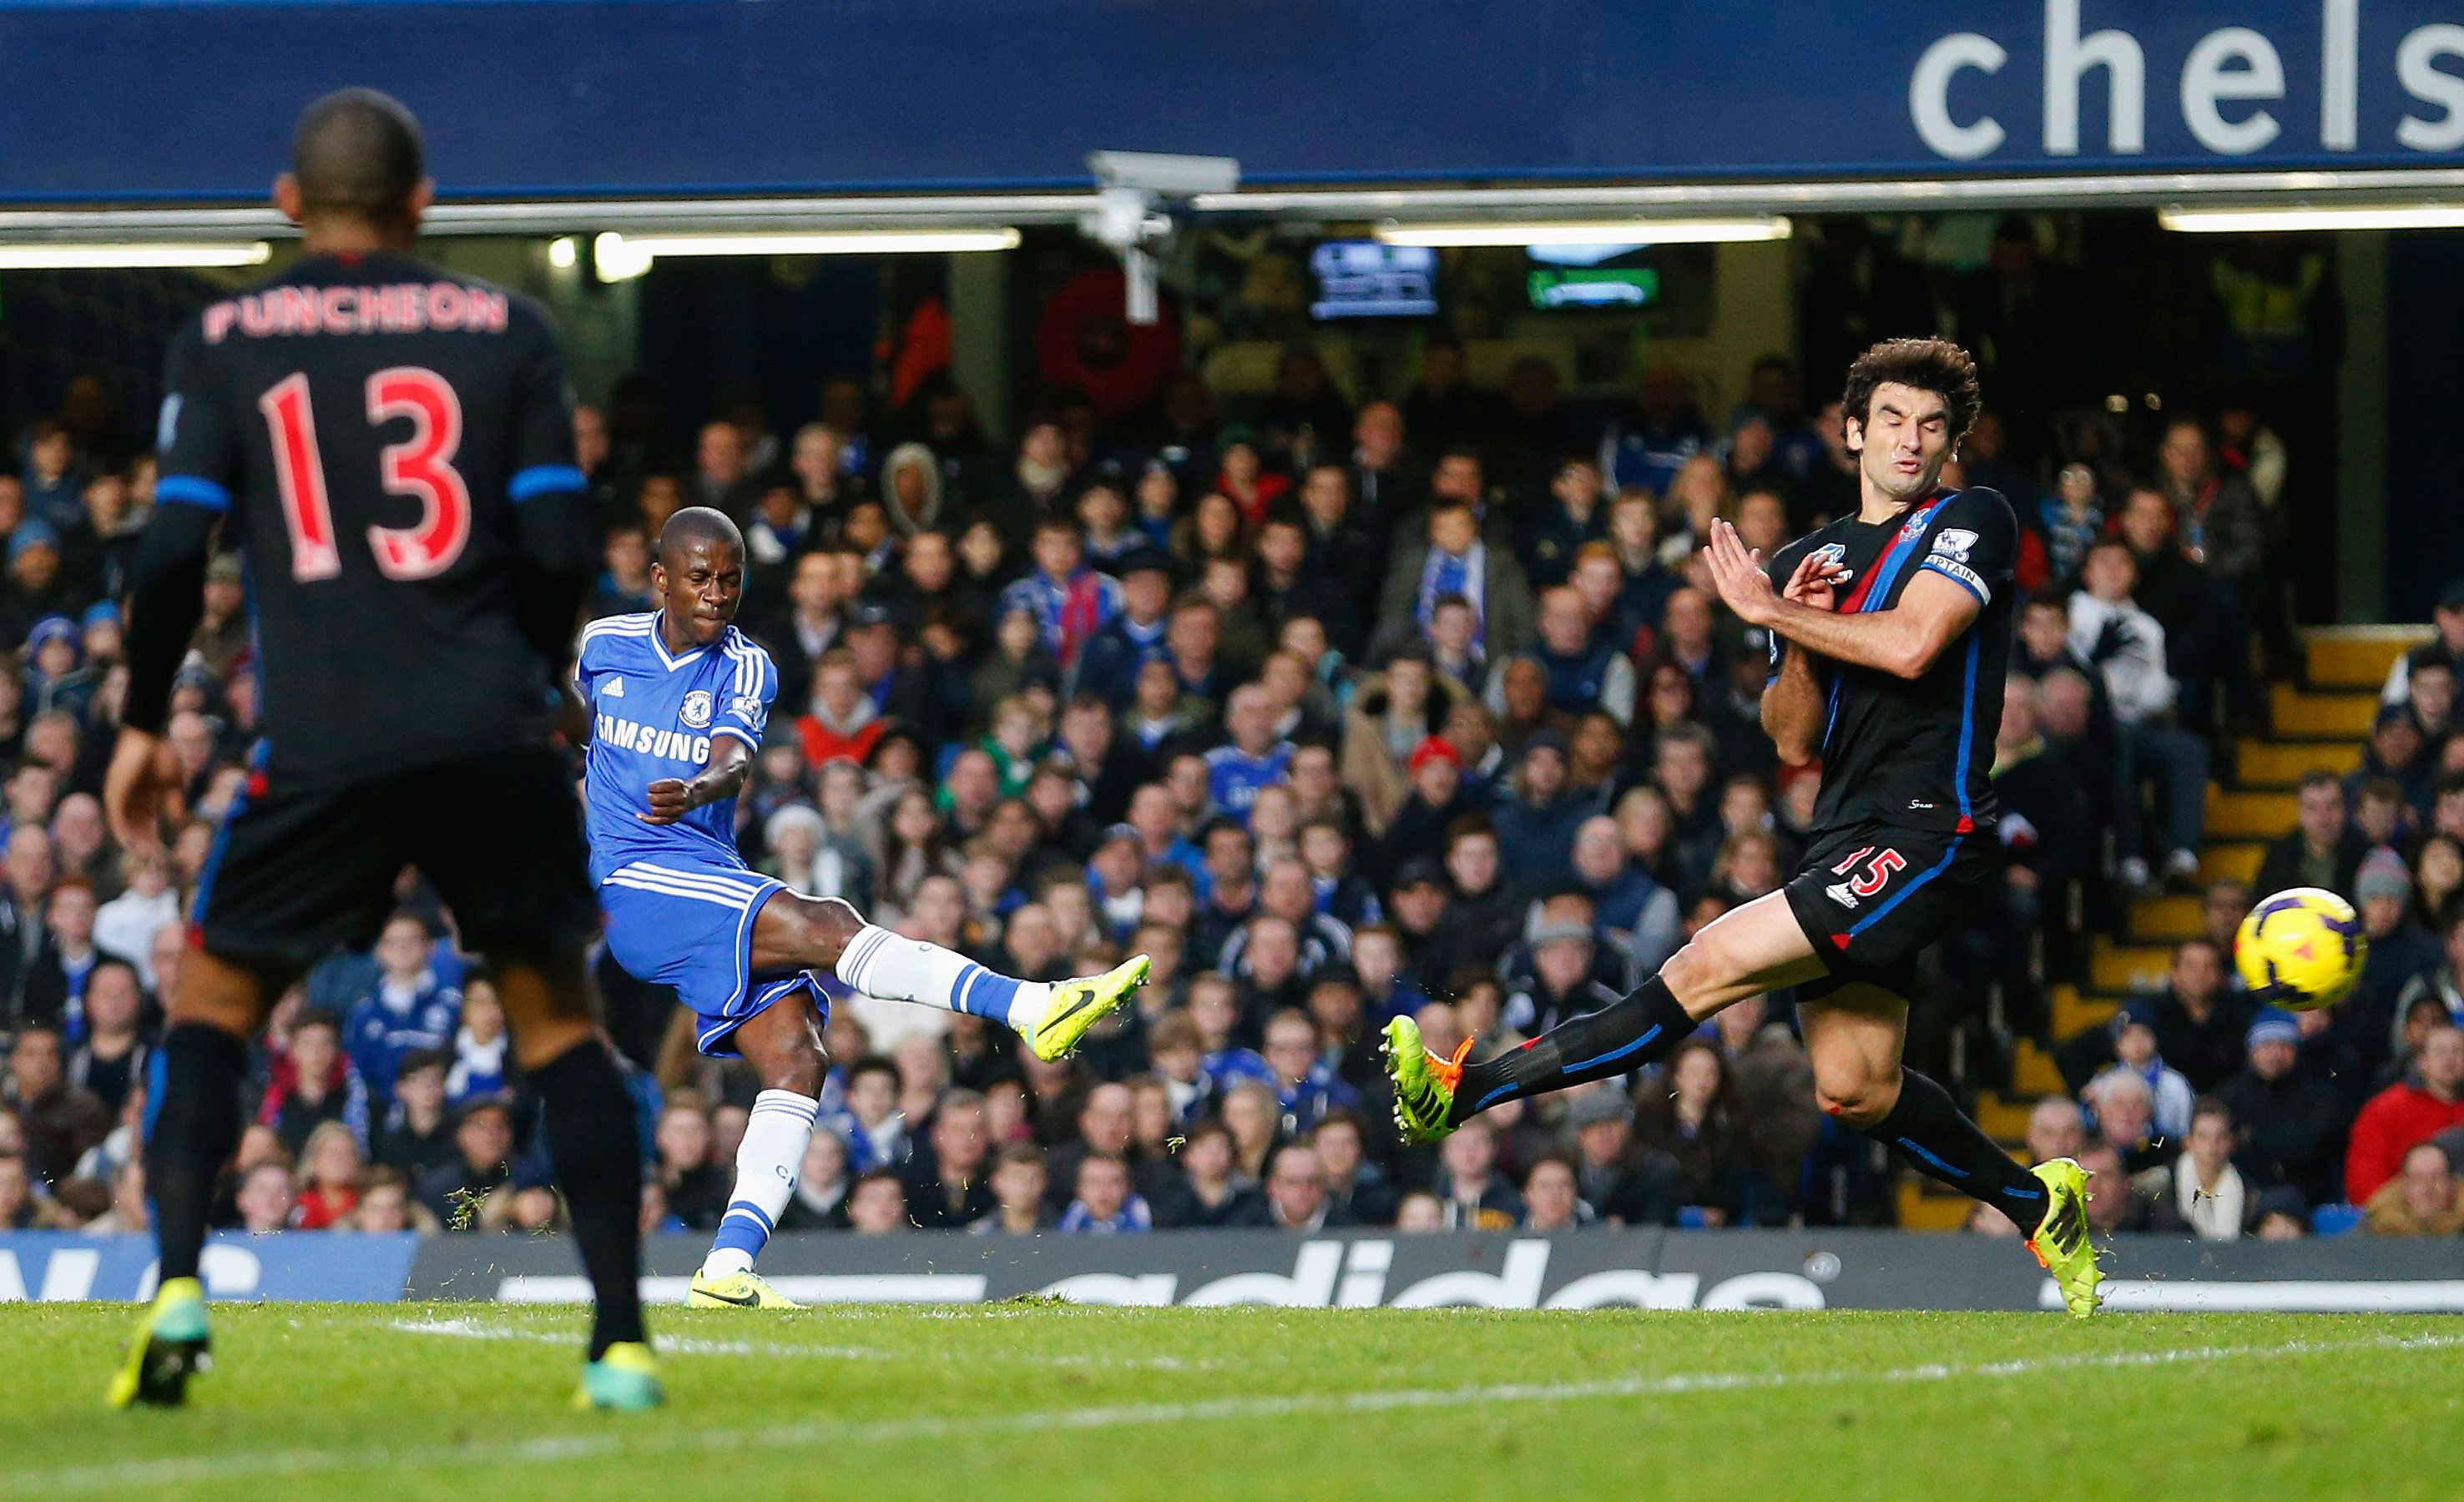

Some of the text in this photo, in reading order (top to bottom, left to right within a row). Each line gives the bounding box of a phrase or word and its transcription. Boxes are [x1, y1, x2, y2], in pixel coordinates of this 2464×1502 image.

[202, 281, 509, 345] PUNCHEON
[258, 365, 472, 582] 13
[1927, 556, 1976, 582] APTAIN
[1830, 845, 1907, 897] 15
